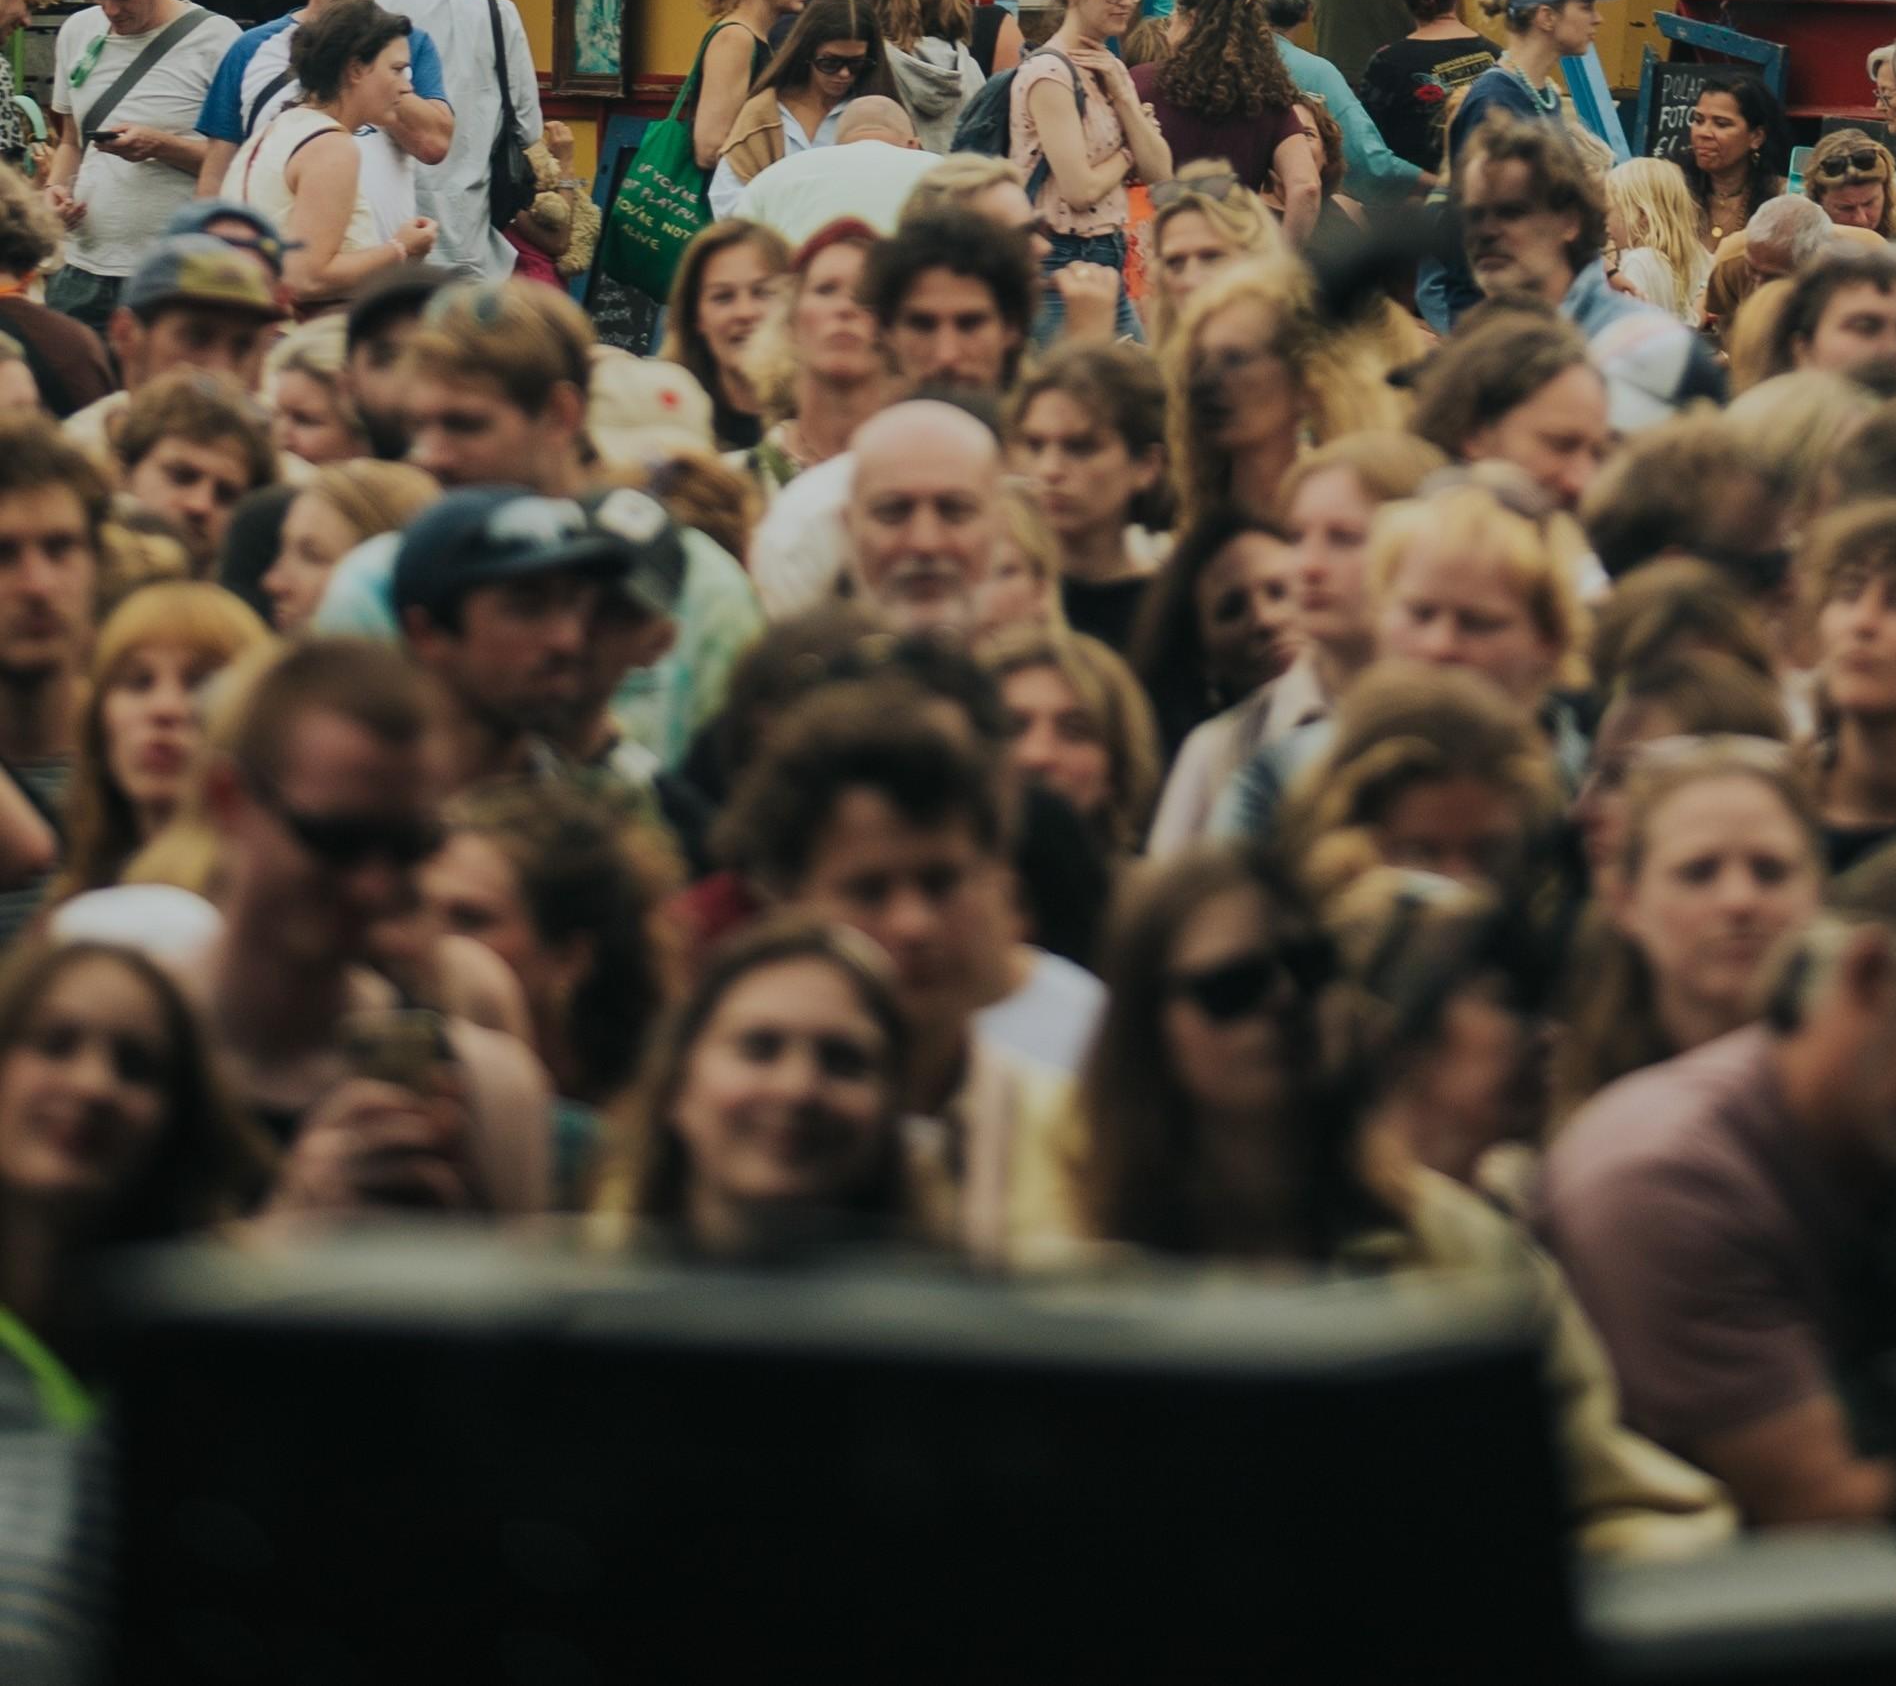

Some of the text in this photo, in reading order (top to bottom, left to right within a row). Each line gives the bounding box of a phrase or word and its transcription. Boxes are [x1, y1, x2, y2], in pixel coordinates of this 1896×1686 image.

[623, 178, 640, 189] OT
[623, 224, 660, 250] ALIVE
[661, 221, 693, 240] NOT
